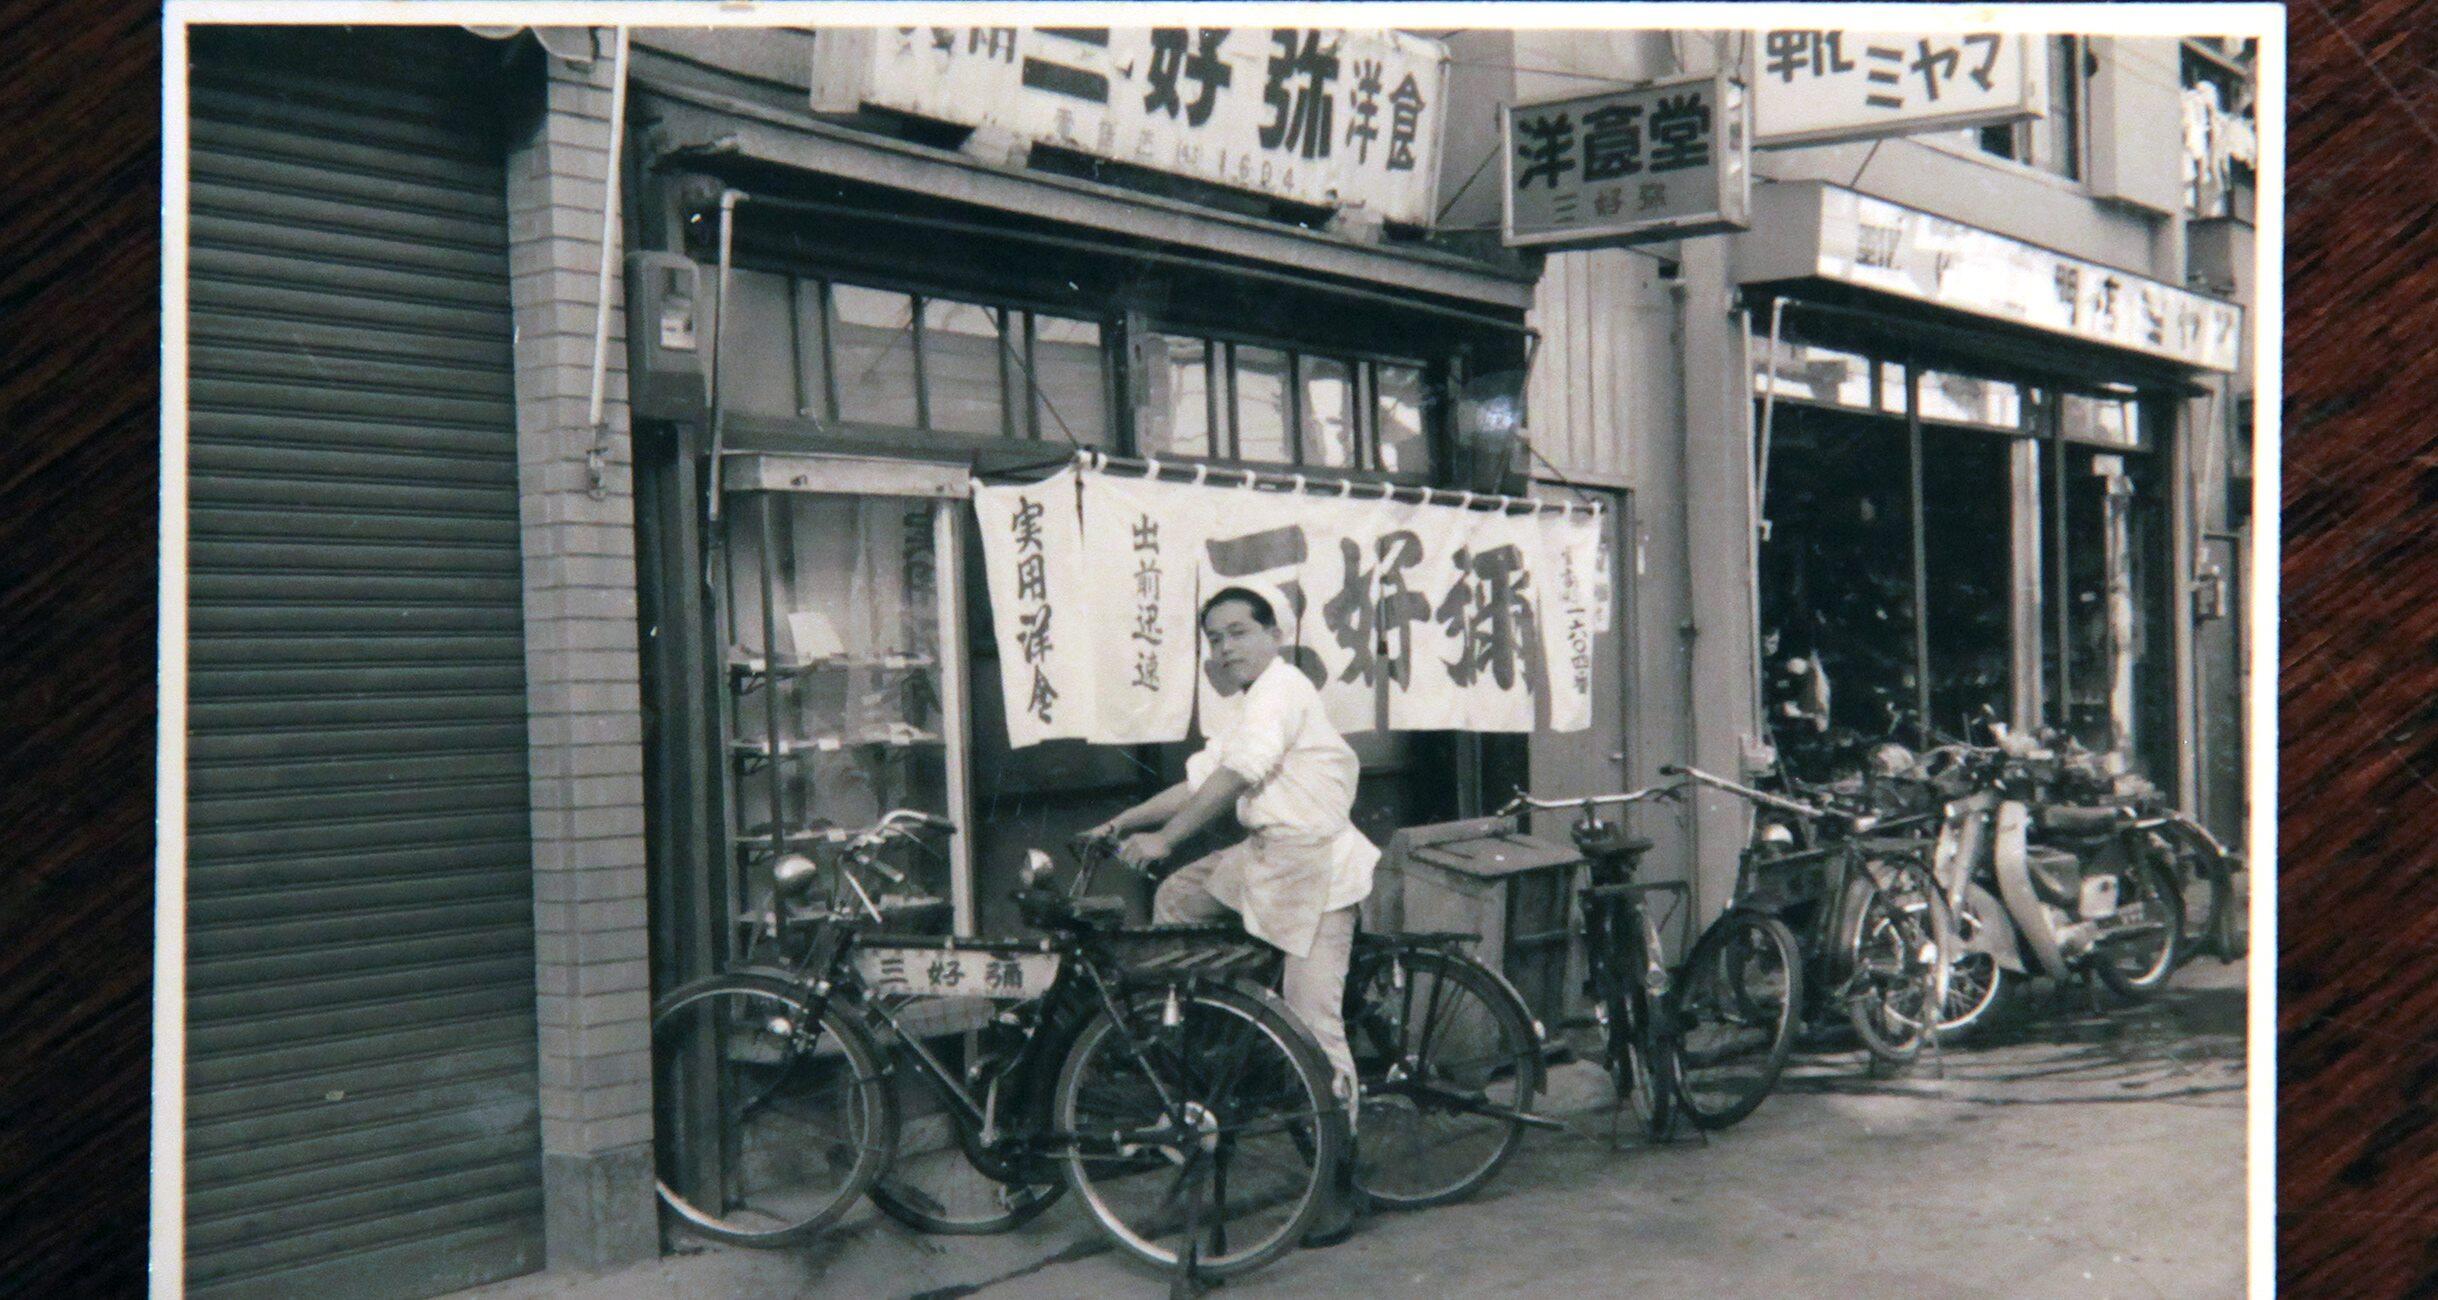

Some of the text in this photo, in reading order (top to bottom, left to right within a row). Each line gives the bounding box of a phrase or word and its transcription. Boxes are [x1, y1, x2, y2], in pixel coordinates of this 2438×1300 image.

[1518, 93, 1711, 189] 洋食堂
[1012, 496, 1058, 724] 実用洋食
[1132, 512, 1163, 692] 出前迅速
